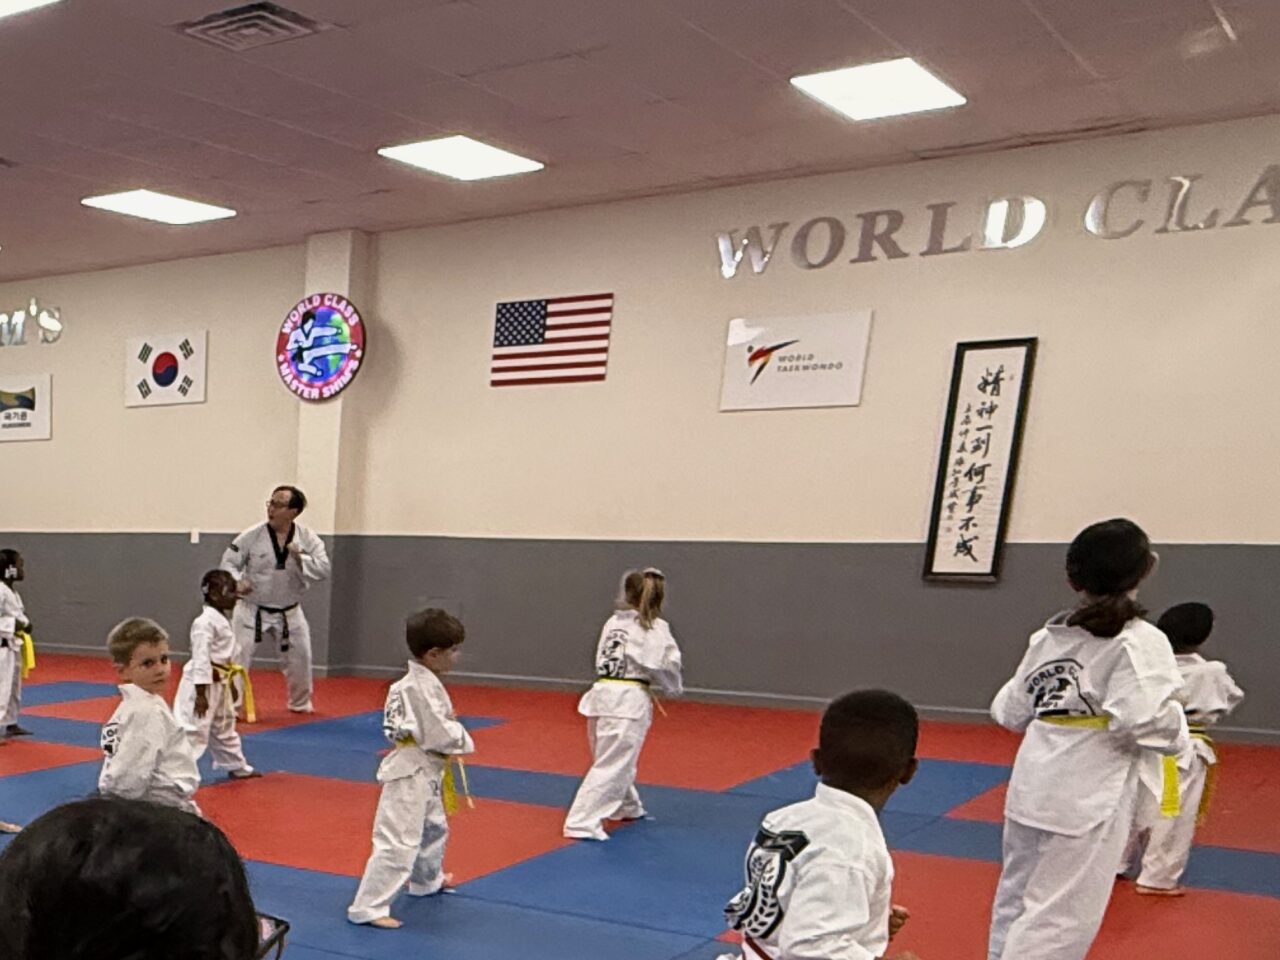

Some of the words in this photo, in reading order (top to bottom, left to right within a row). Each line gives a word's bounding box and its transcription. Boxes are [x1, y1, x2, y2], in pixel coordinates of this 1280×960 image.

[717, 193, 1047, 279] WORLD
[281, 295, 322, 335] WORLD
[323, 294, 360, 327] CLASS
[776, 362, 843, 373] TAEKWONDO
[777, 353, 815, 363] WORLD
[278, 361, 321, 400] MASTER
[322, 359, 360, 398] SHIM'S
[1027, 665, 1066, 695] WORLD
